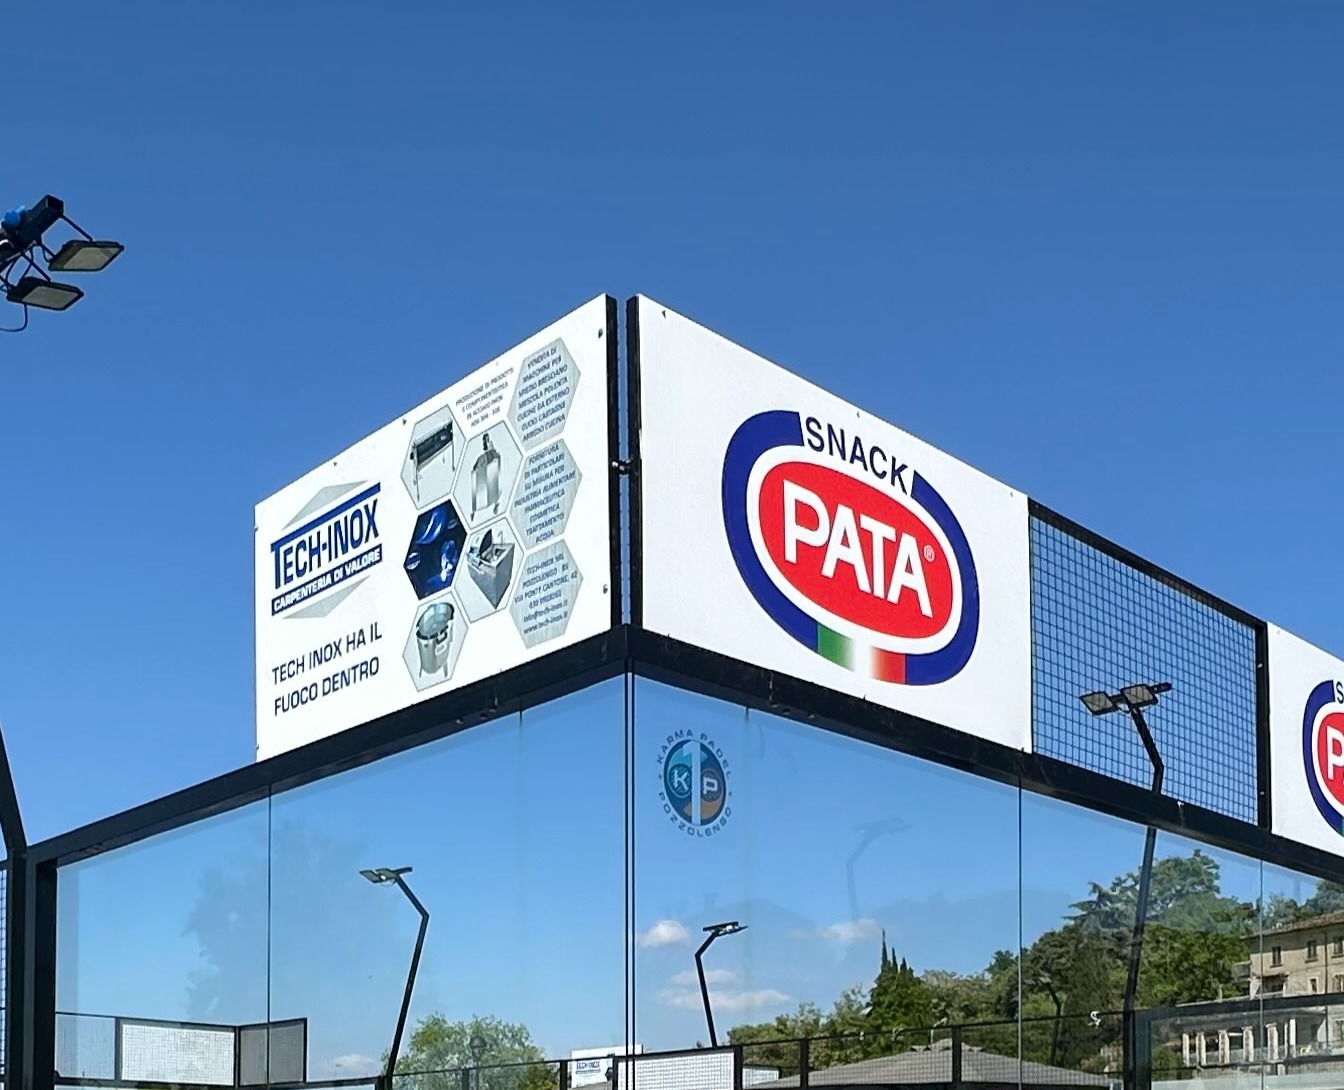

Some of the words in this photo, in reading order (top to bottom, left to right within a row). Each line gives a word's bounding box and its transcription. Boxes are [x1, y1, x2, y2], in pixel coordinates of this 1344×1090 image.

[805, 416, 908, 495] SNACK
[270, 481, 381, 593] TECH-INOX
[273, 573, 332, 611] CARPENTERIA
[333, 565, 344, 583] DI
[345, 548, 380, 575] VALORE
[271, 655, 304, 685] TECH
[308, 639, 342, 669] INOX
[345, 628, 366, 654] HA
[370, 621, 382, 643] IL
[274, 681, 318, 716] FUOCO
[321, 656, 379, 697] DENTRO
[657, 729, 694, 764] KARMA
[700, 733, 731, 779] PADEL
[659, 791, 732, 838] POZZOLENGO
